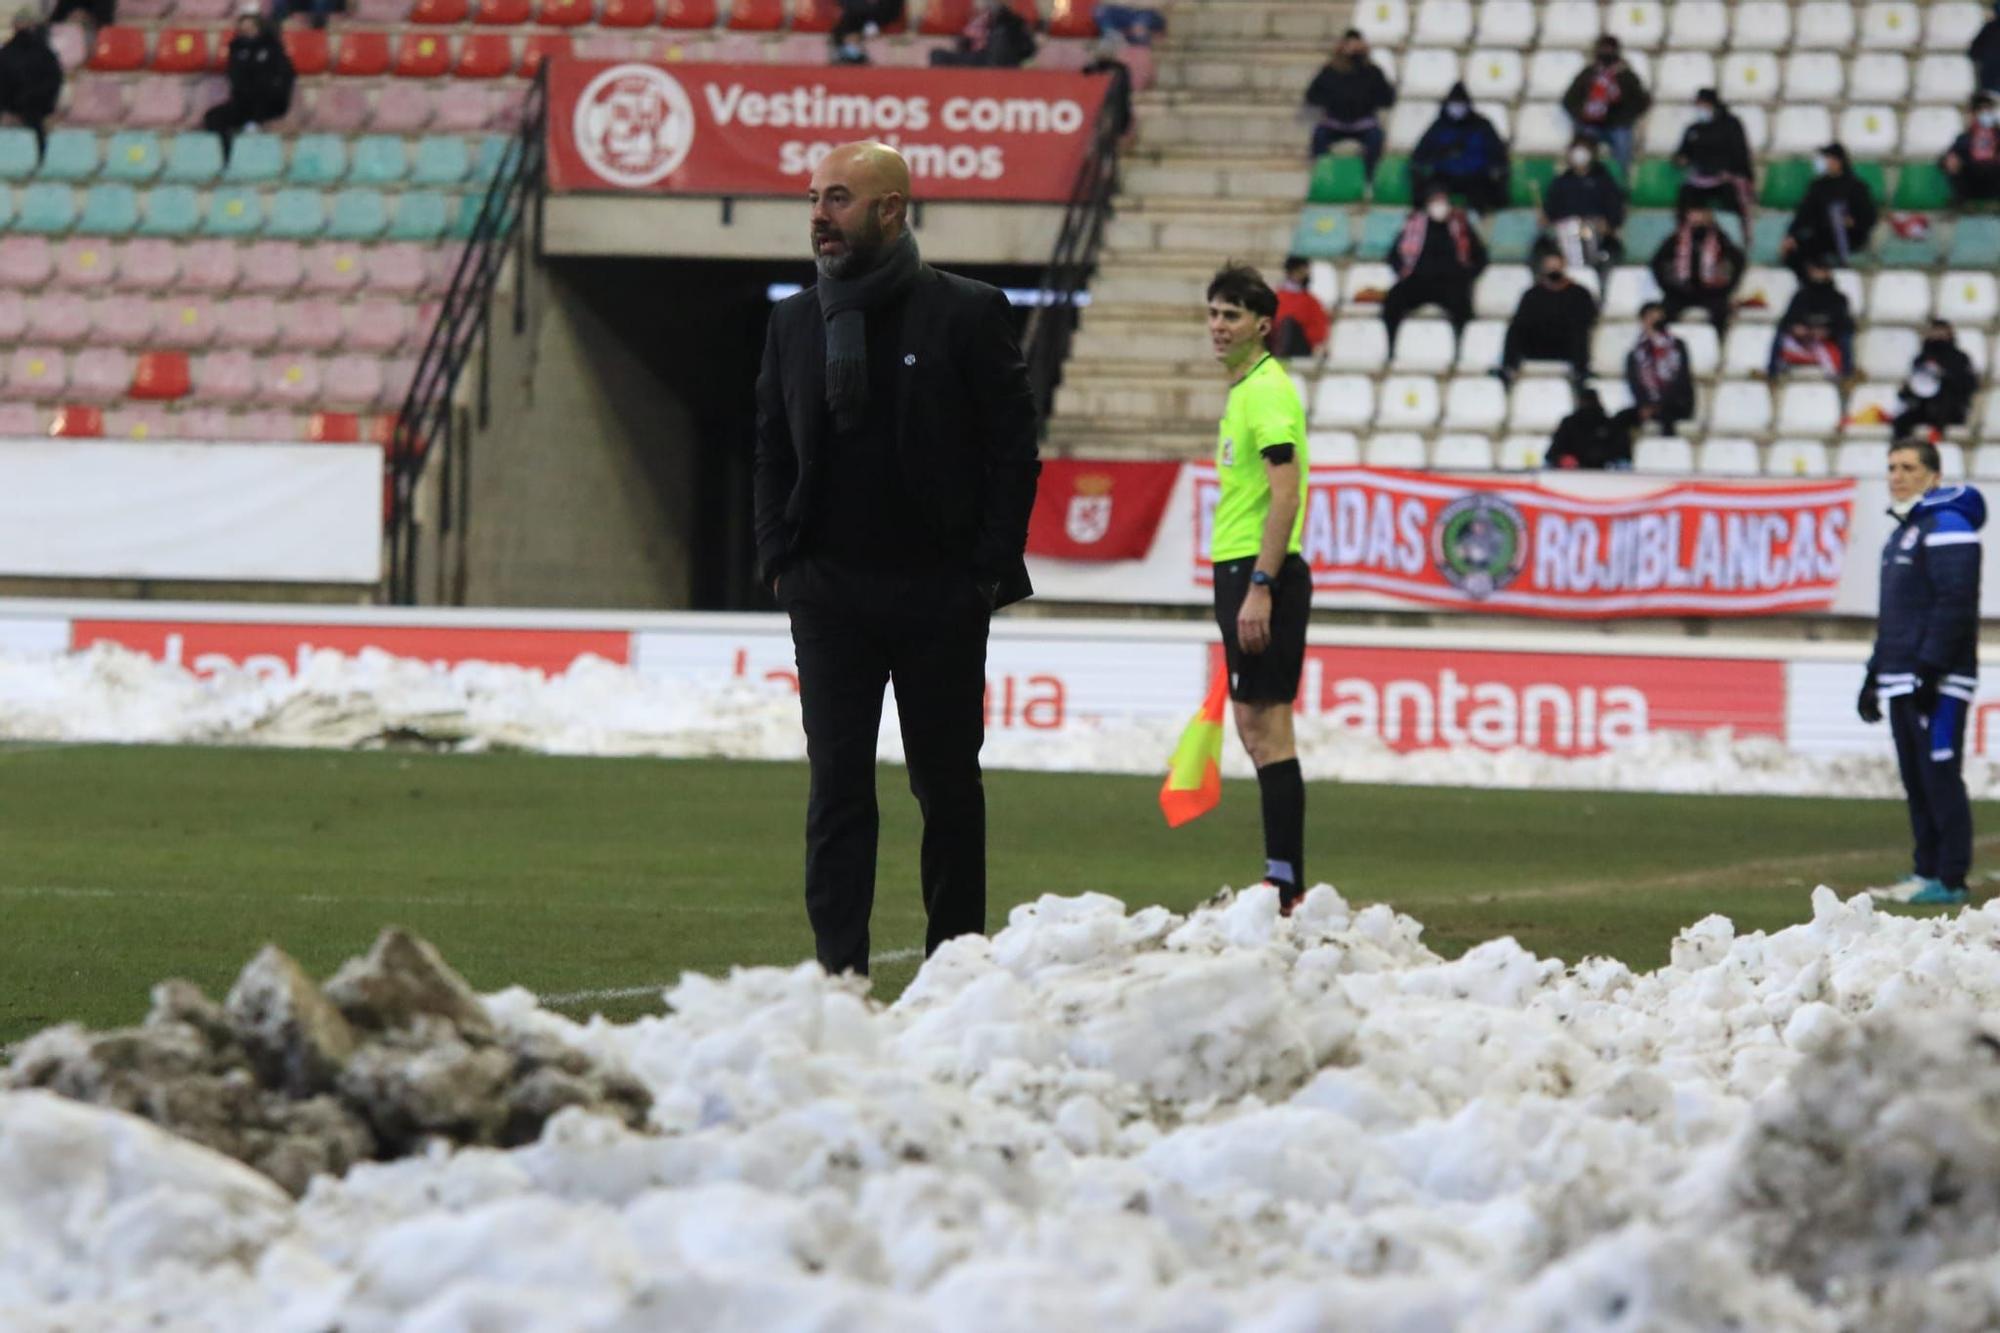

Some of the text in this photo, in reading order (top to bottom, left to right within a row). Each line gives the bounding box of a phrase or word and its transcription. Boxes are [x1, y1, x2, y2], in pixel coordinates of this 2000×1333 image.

[704, 82, 1084, 135] Vestimos como
[1533, 506, 1848, 592] ROJIBLANCAS
[1304, 657, 1650, 748] lantania
